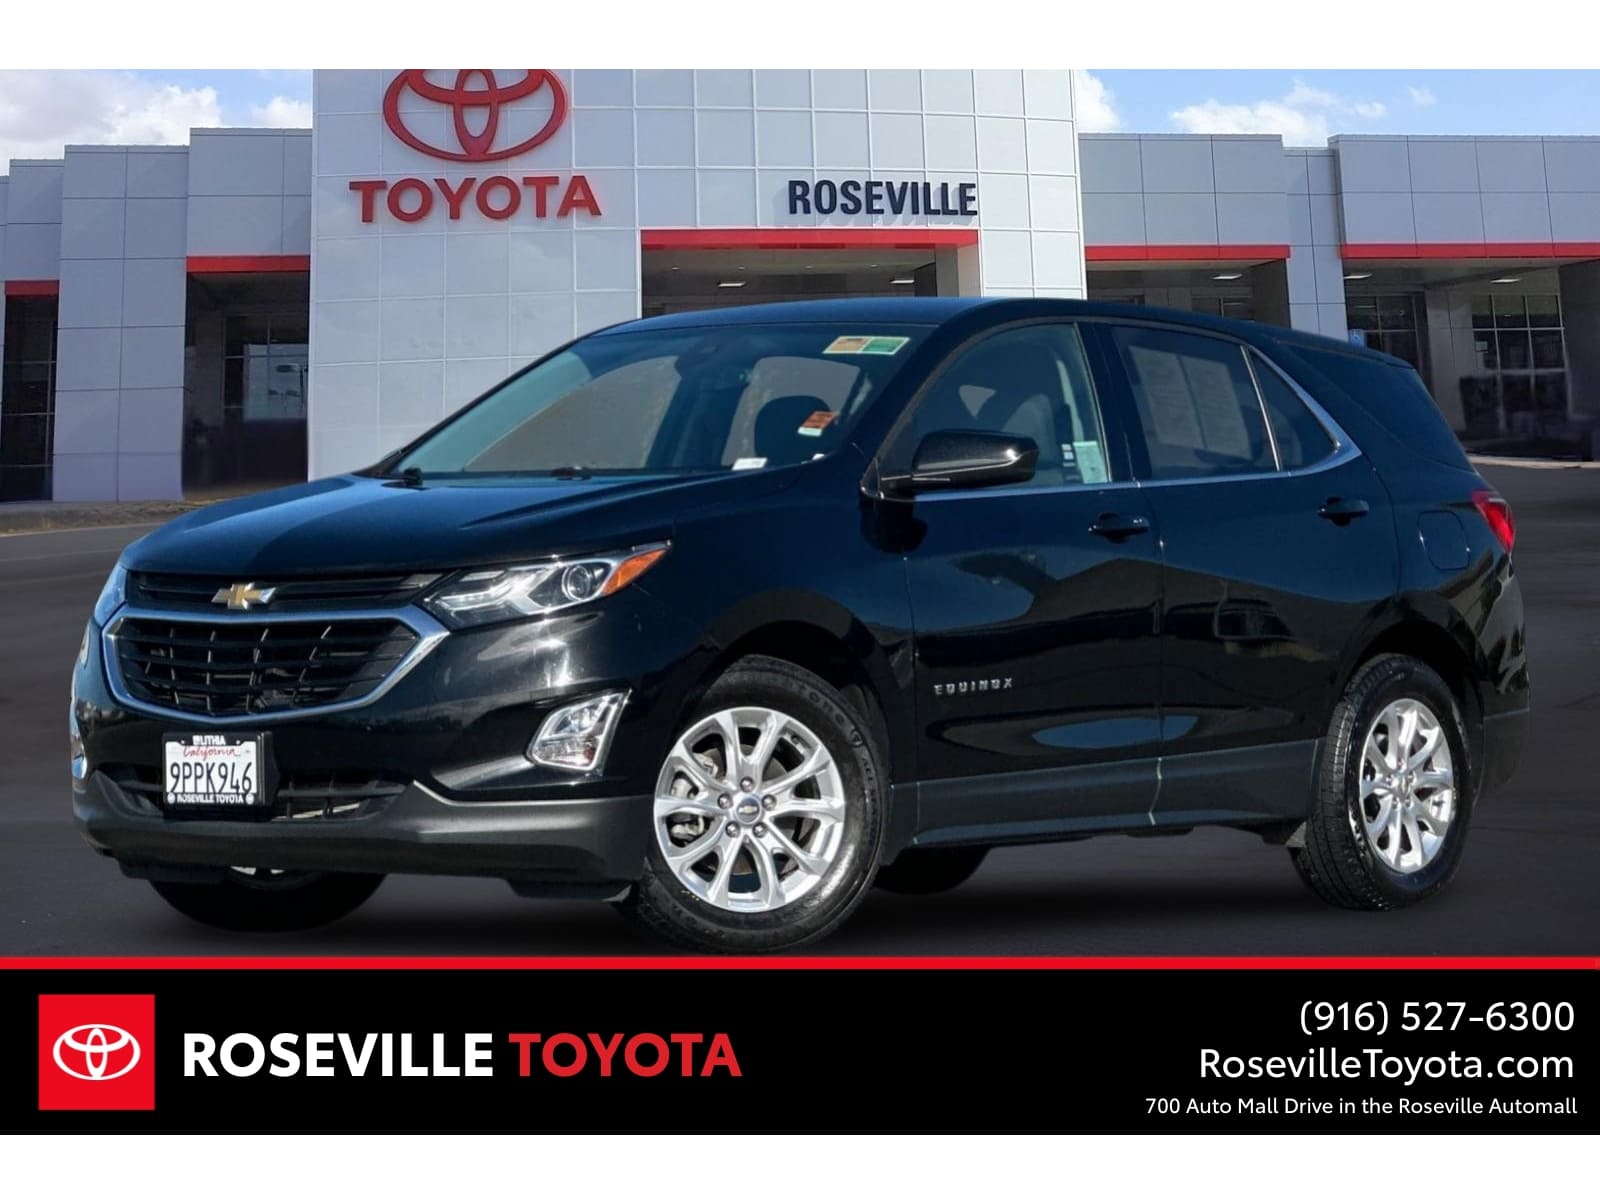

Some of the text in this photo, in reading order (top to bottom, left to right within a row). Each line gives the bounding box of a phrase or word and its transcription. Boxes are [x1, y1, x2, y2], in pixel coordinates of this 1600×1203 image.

[349, 175, 602, 223] TOYOTA
[788, 180, 978, 216] ROSEVILLE
[934, 678, 1013, 695] EQUINOX
[183, 745, 240, 761] California
[170, 762, 252, 793] 9PPK946
[177, 793, 244, 804] ROSEVILLE TOYOTA
